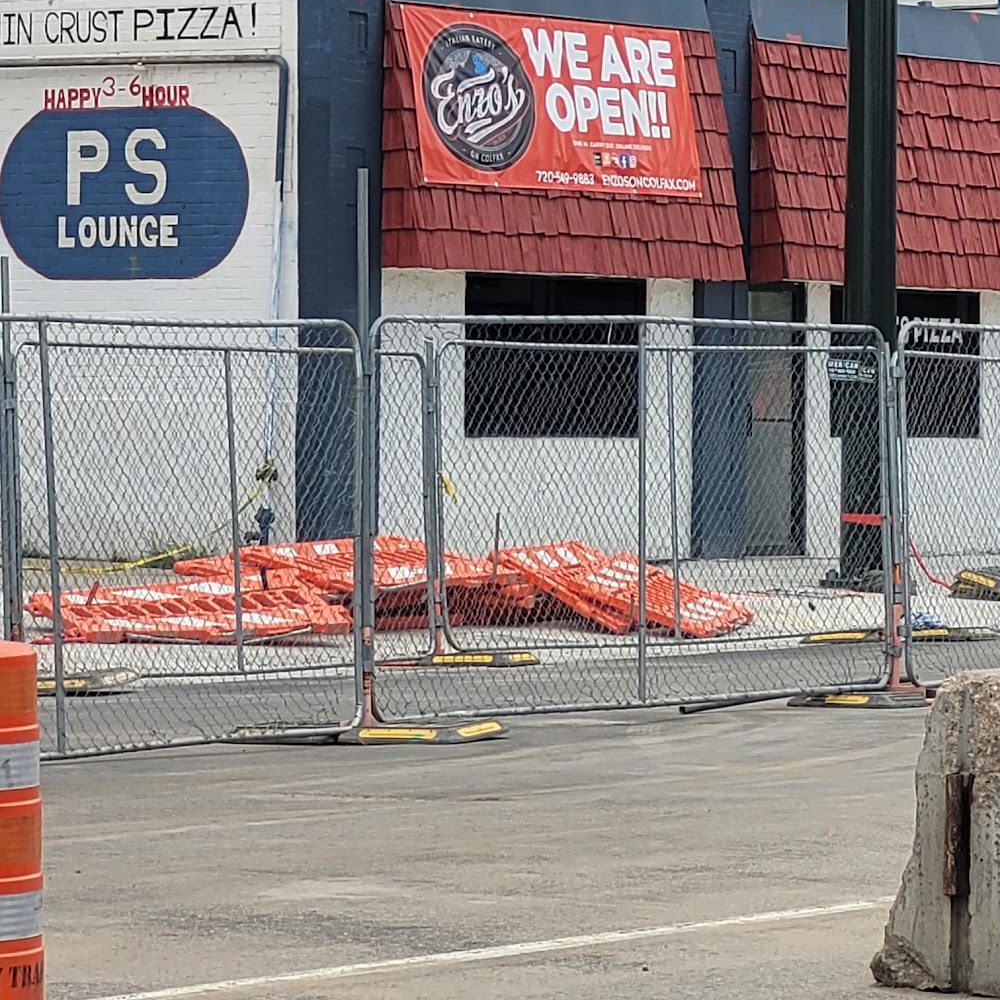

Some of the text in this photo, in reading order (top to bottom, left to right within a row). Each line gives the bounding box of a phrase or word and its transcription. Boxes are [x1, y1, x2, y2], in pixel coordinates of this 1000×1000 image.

[44, 10, 124, 44] CRUST
[133, 3, 257, 40] PIZZA!
[445, 34, 496, 51] ITALIAN EATERY
[521, 27, 677, 88] WE ARE
[44, 75, 191, 111] HAPPY 3-6 HOUR
[430, 65, 526, 143] Enzo's
[545, 82, 671, 139] OPEN!!
[66, 128, 168, 206] PS
[470, 150, 504, 163] ON COLFAX
[535, 170, 697, 191] 720-549-9883 ENZOSONCOLFAX.COM
[57, 214, 179, 249] LOUNGE
[914, 316, 963, 343] PIZZA
